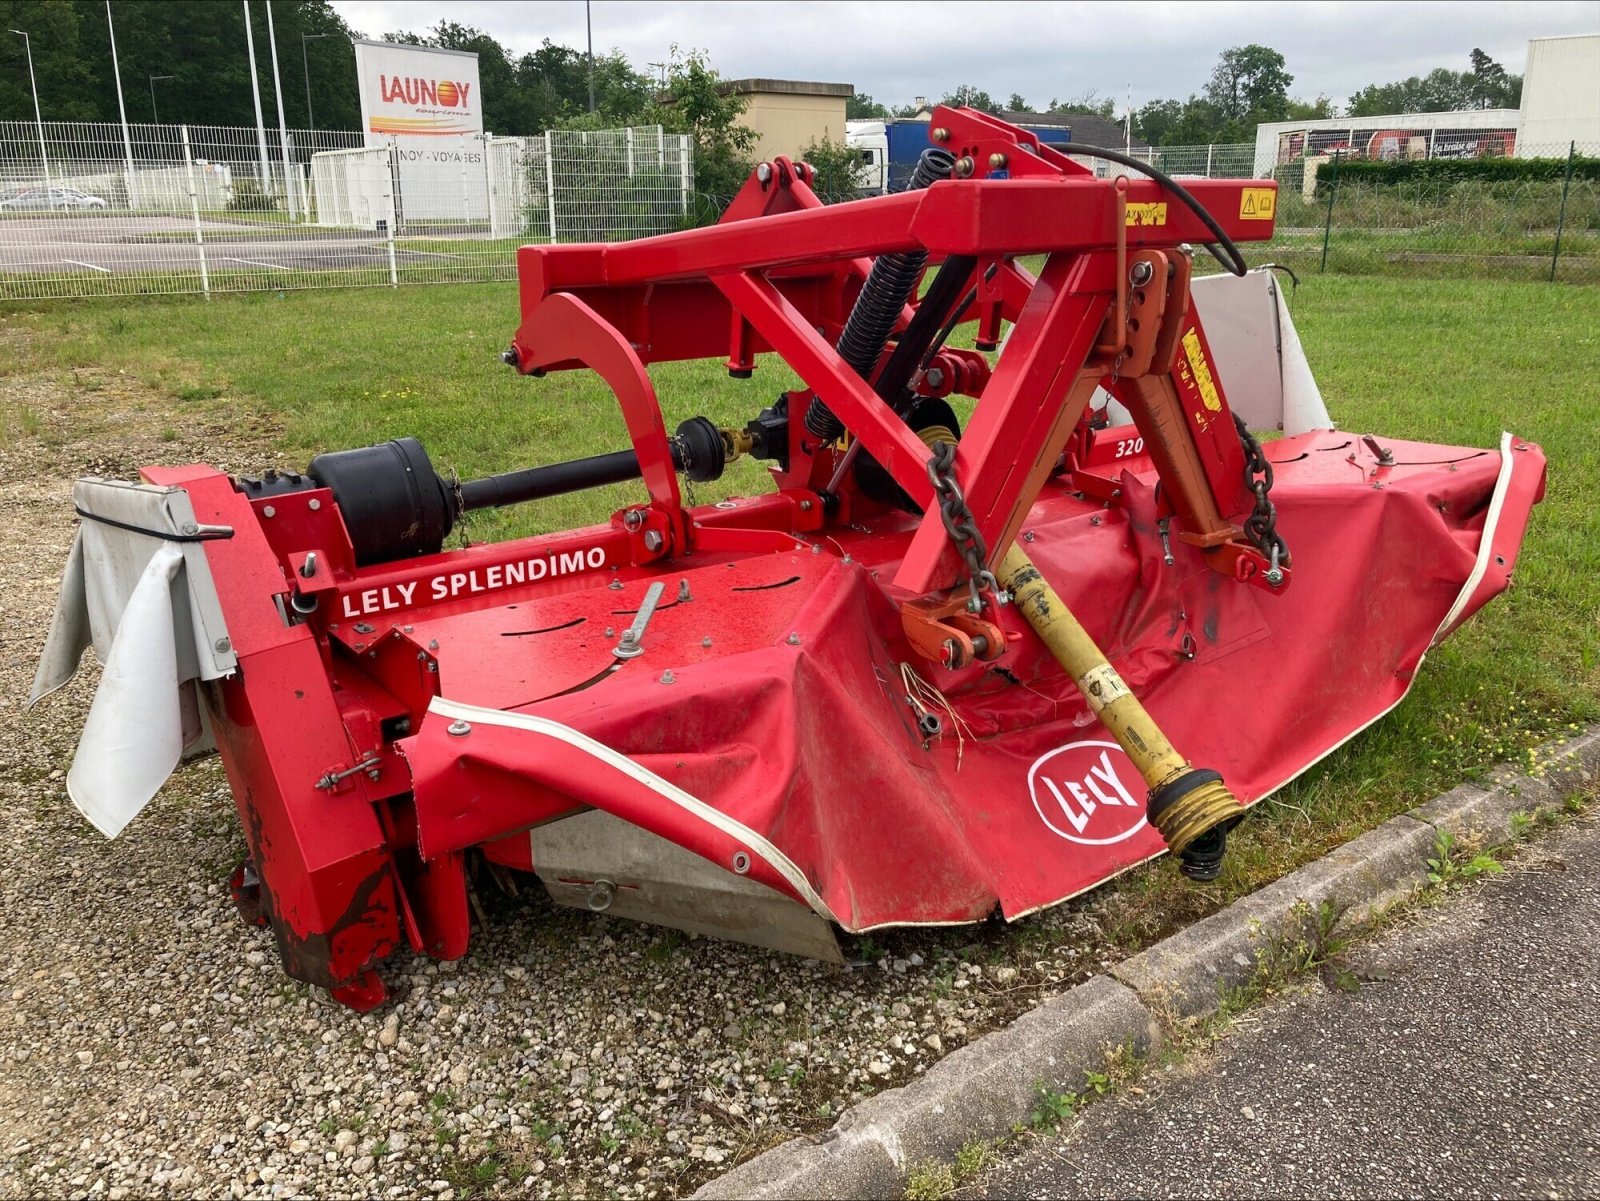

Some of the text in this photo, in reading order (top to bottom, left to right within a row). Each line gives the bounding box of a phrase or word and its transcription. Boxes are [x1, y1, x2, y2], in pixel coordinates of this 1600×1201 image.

[380, 74, 470, 108] LAUNOY
[432, 151, 481, 163] VOYAGES
[1115, 437, 1144, 458] 320
[343, 547, 606, 618] LELY SPLENDIMO
[1040, 750, 1139, 834] LELY
